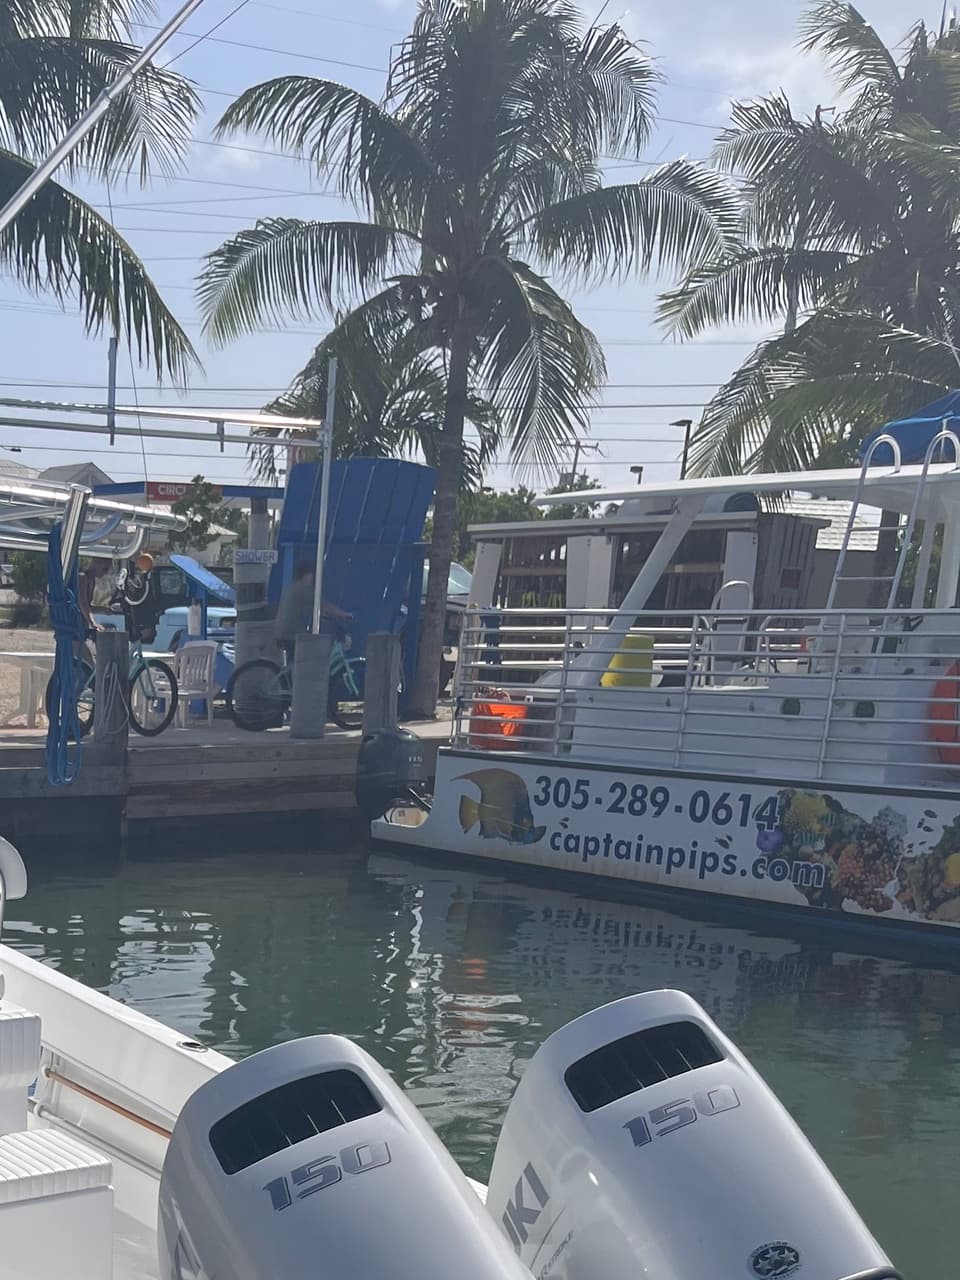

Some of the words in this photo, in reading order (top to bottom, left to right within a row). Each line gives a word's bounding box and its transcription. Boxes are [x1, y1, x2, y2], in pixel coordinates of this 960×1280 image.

[235, 551, 275, 561] SHOWER
[549, 831, 826, 888] captainpips.com
[622, 1085, 741, 1148] 150
[262, 1140, 392, 1212] 150
